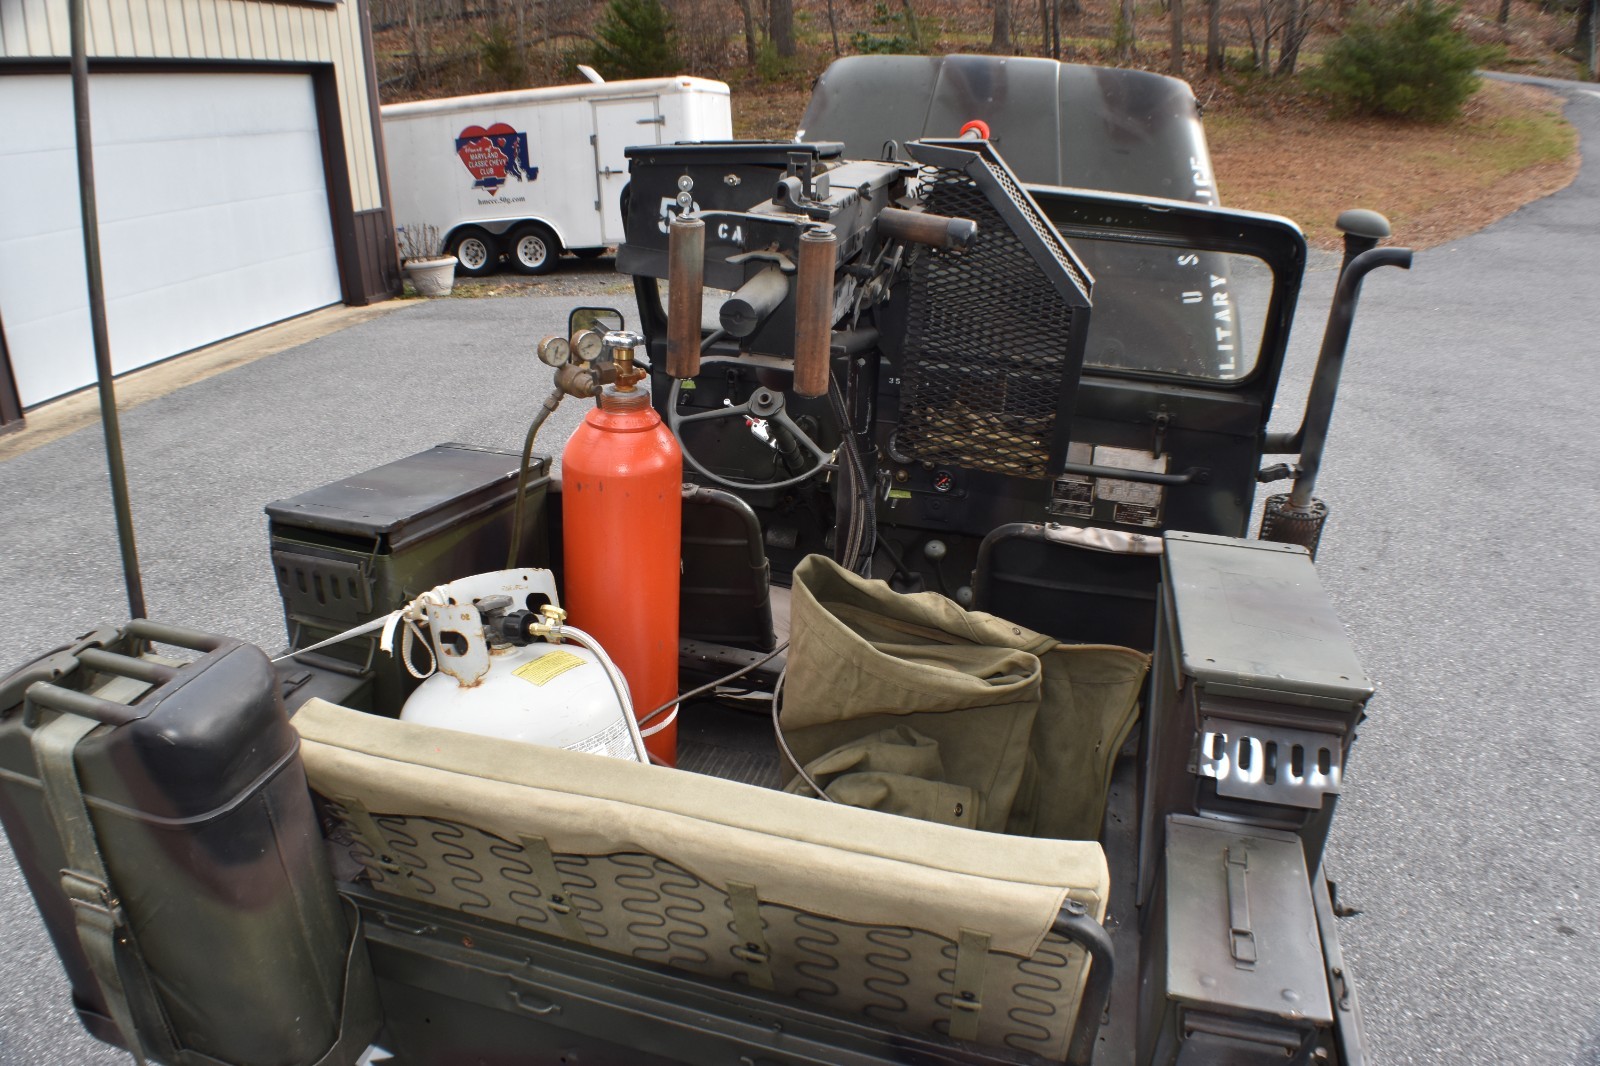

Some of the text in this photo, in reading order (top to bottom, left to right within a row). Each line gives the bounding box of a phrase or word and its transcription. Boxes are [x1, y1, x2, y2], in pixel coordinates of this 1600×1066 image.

[468, 158, 506, 168] CLASSIC CHEVY
[469, 151, 498, 160] MARYLAND
[479, 167, 494, 175] CLUB
[1177, 253, 1203, 304] U S
[1209, 274, 1236, 380] ILITARY
[1203, 732, 1263, 783] 50
